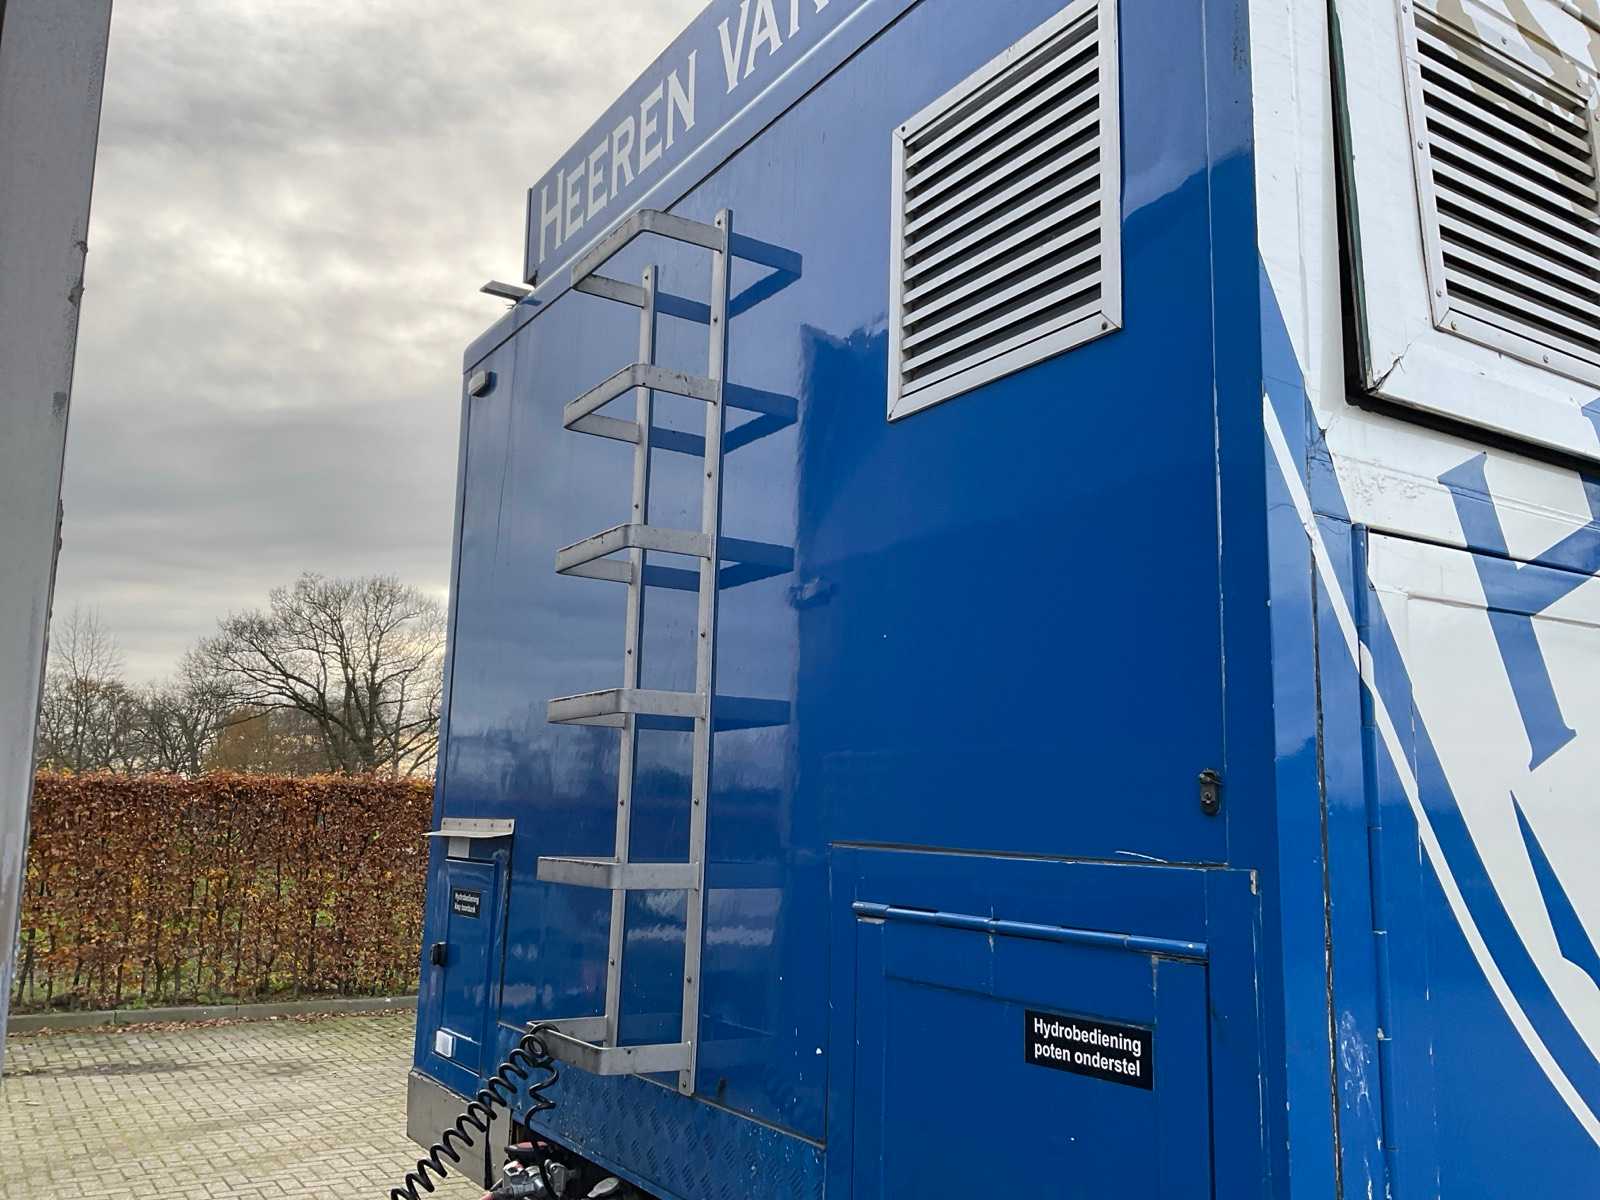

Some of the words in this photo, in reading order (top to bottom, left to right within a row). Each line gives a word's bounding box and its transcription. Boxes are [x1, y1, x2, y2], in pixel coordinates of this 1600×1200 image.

[538, 49, 698, 264] HEEREN
[1033, 1017, 1142, 1057] Hydrobediening
[1034, 1042, 1071, 1062] poten
[1074, 1051, 1141, 1077] onderstel
